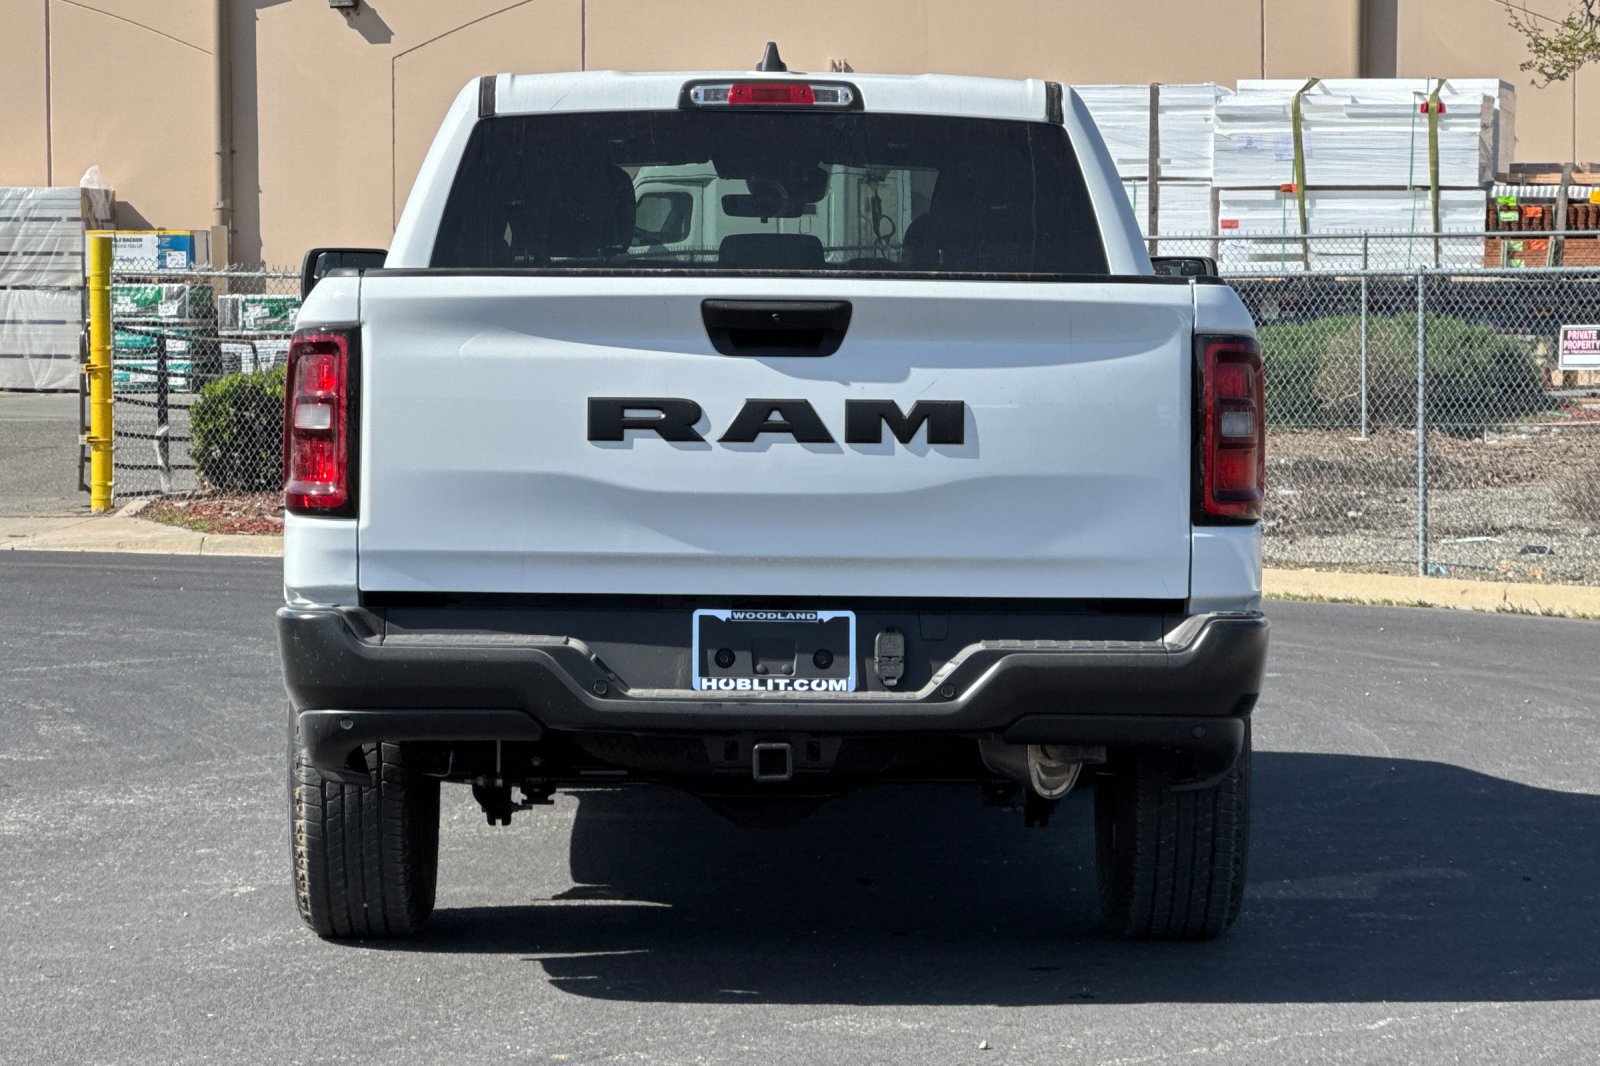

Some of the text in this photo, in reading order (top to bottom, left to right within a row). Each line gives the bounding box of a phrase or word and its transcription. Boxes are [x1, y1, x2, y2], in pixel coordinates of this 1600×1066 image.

[1567, 330, 1598, 339] PRIVATE
[1563, 340, 1600, 349] PROPERTY
[587, 396, 964, 444] RAM
[732, 611, 817, 620] WOODLAND
[701, 678, 847, 691] HOBLIT.COM
